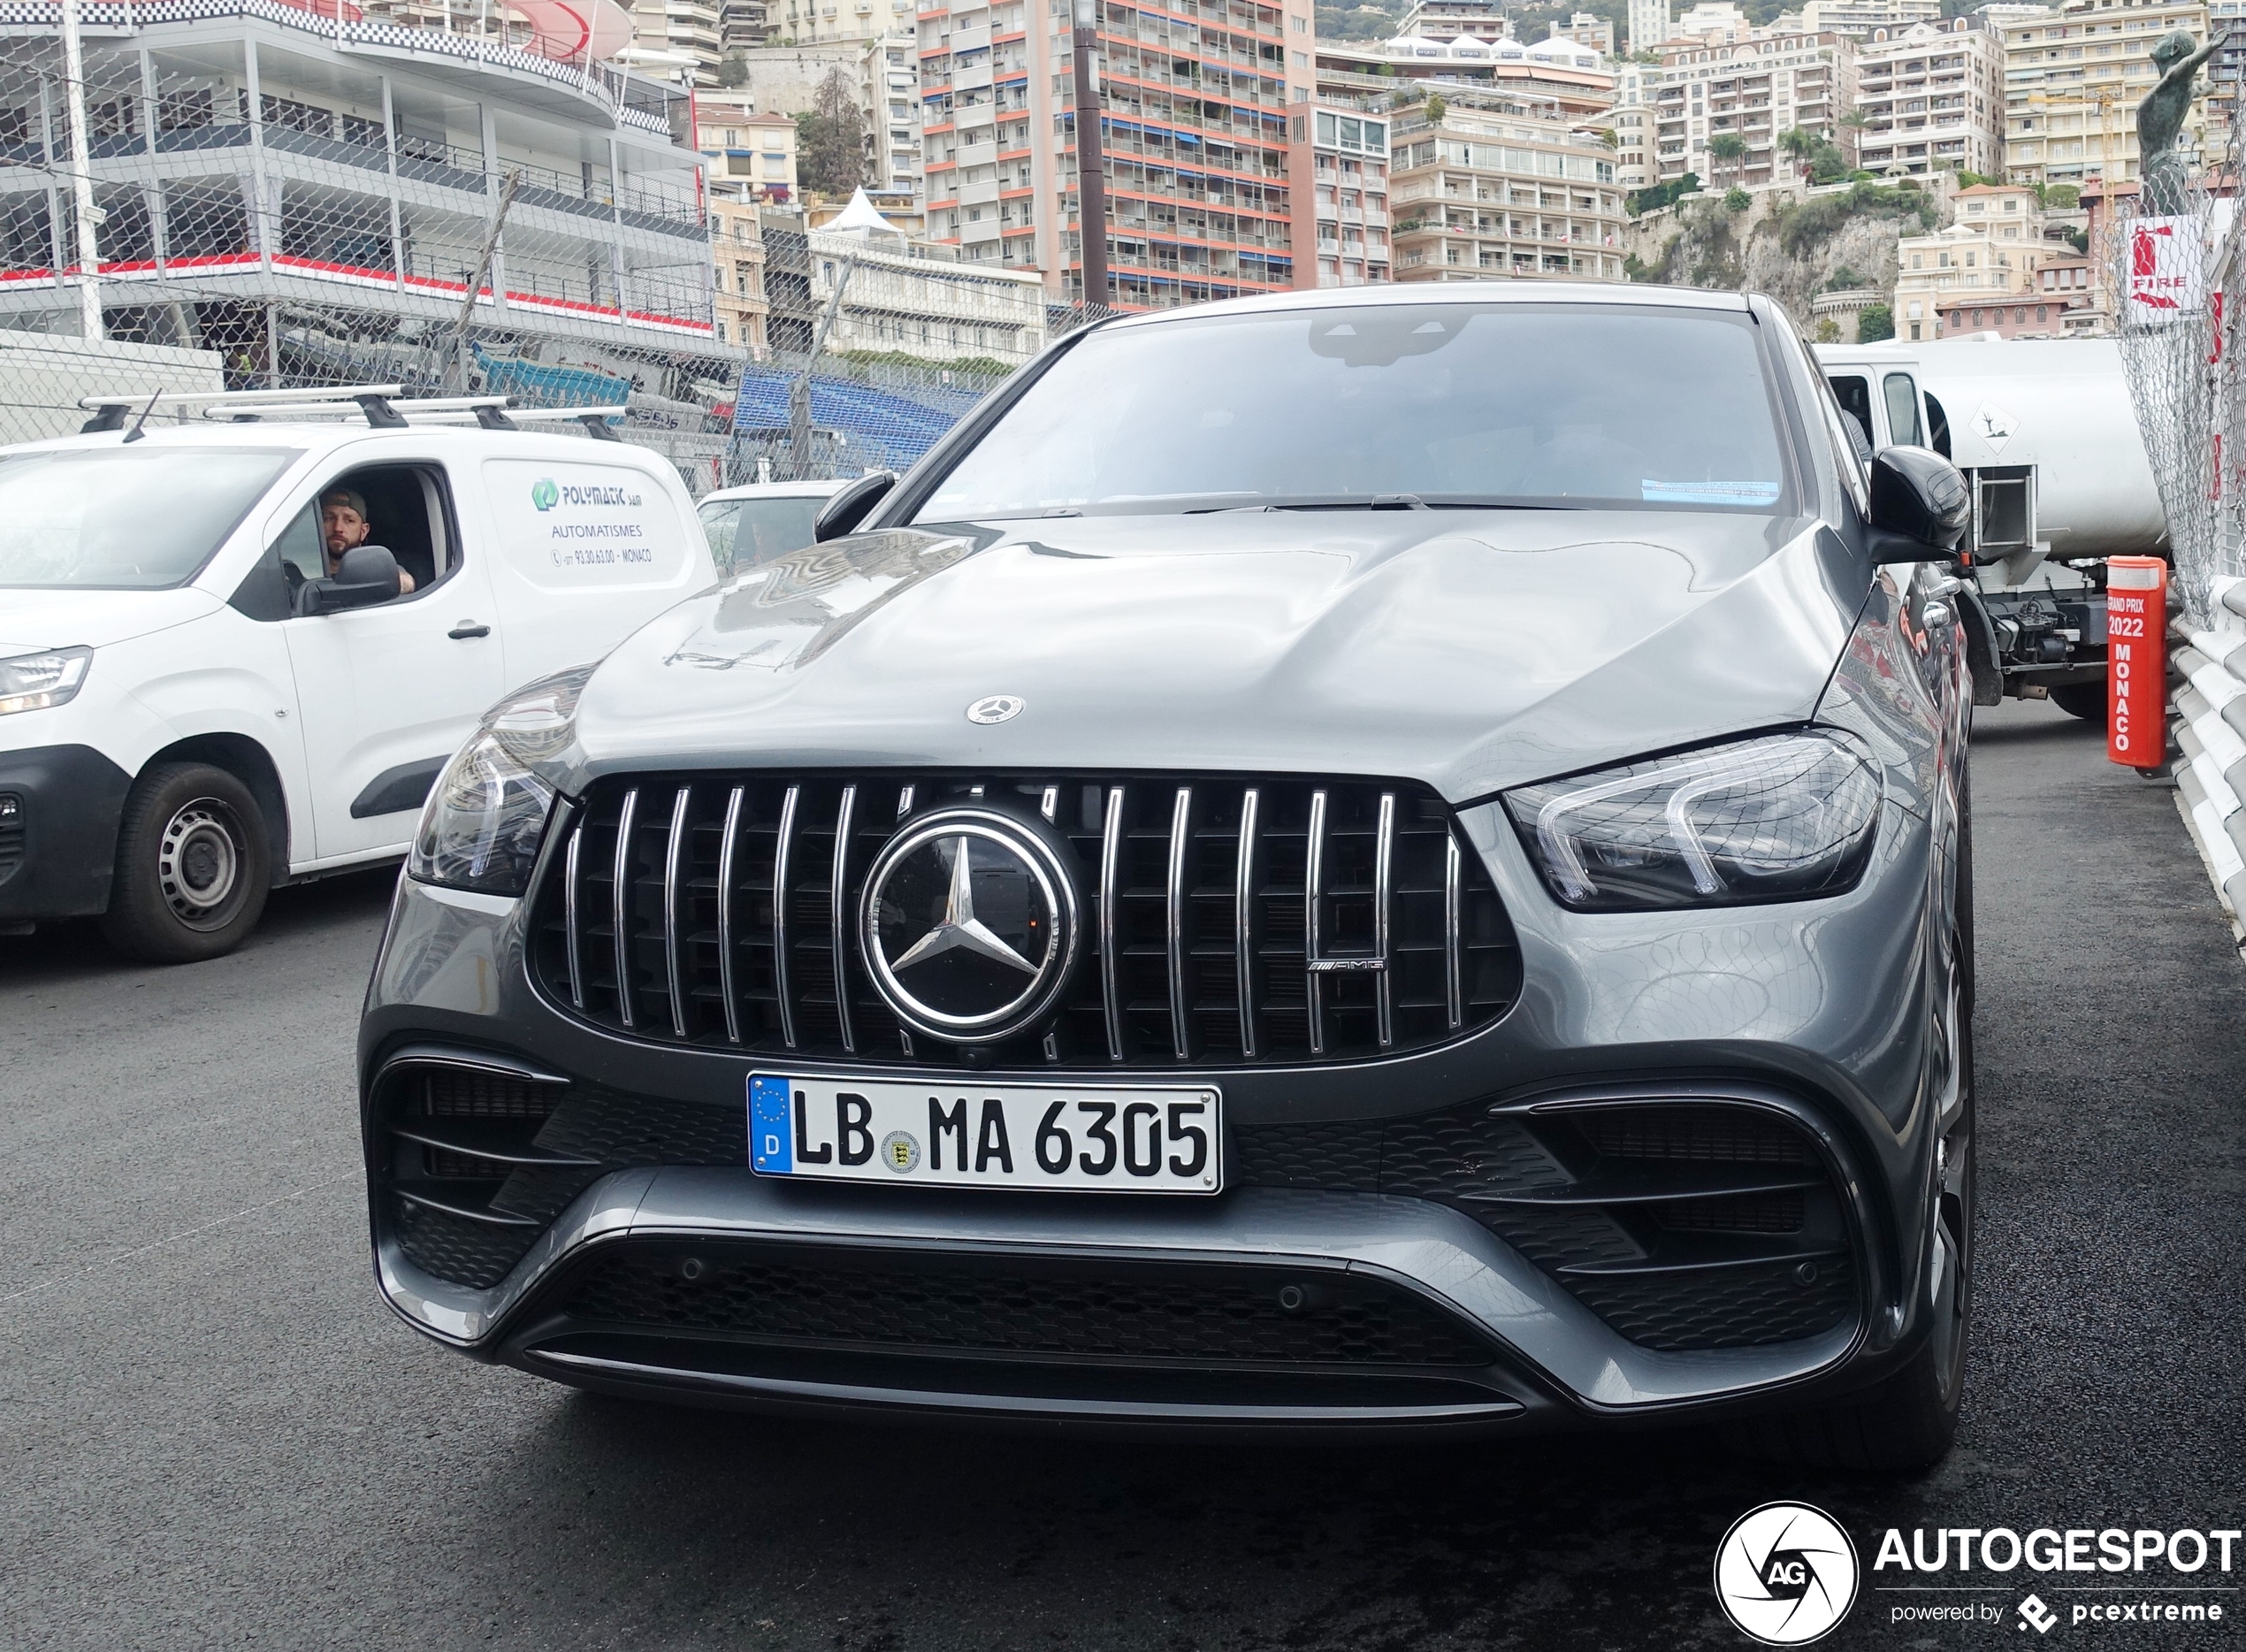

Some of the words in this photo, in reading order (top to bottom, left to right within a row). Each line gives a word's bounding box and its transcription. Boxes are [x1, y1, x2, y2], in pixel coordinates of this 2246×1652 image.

[2134, 277, 2187, 289] FIRE
[562, 486, 626, 506] POLYMATIC
[552, 524, 643, 539] AUTOMATISMES
[575, 548, 615, 565] 93.30.63.00
[622, 548, 652, 563] MONACO
[2107, 596, 2125, 613] GRAND
[2126, 598, 2144, 614] PRIX
[2108, 614, 2144, 637] 2022
[2115, 643, 2130, 752] MONACO
[1333, 960, 1384, 970] AMG
[765, 1133, 780, 1156] D
[793, 1090, 875, 1166] LB
[928, 1096, 1014, 1174] MA
[1035, 1099, 1208, 1178] 6305
